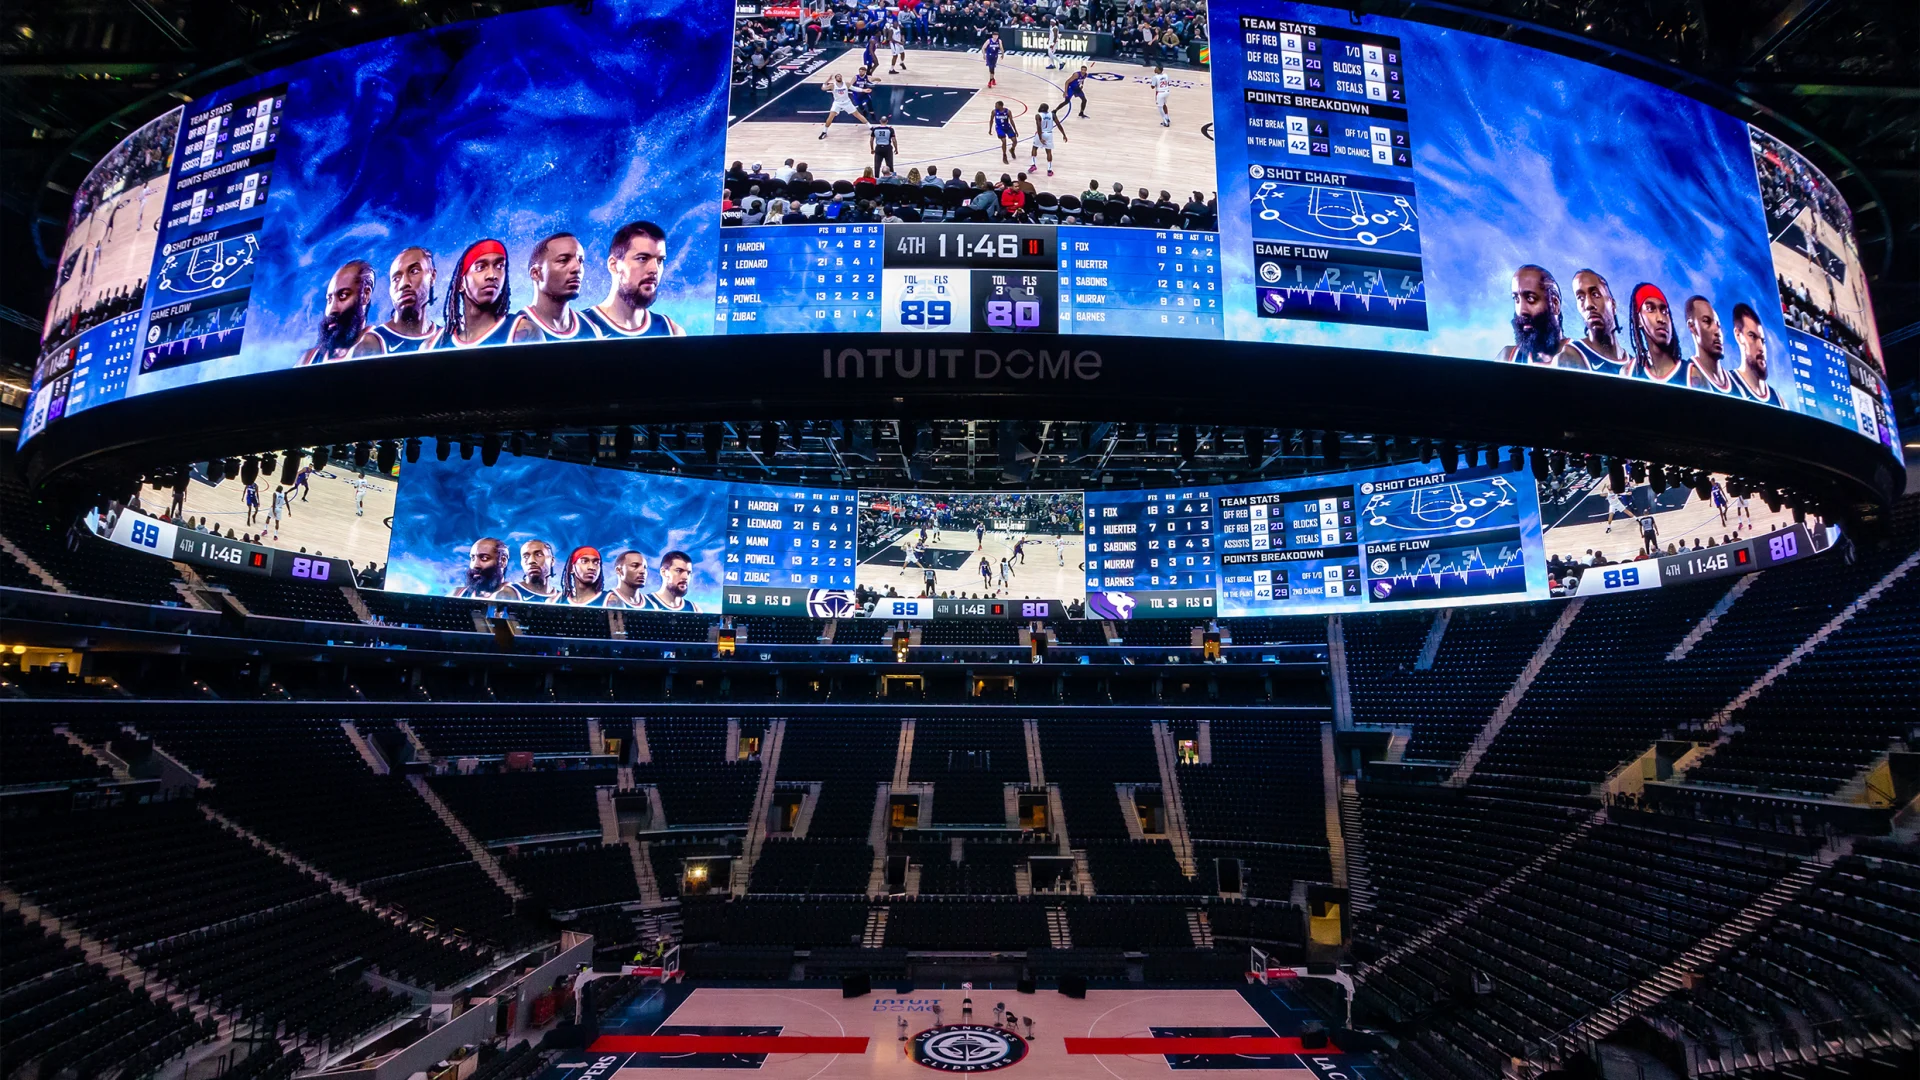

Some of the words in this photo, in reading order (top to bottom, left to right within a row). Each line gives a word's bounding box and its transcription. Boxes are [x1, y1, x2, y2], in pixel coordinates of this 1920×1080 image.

[1242, 18, 1276, 30] TEAM
[1280, 22, 1316, 35] STATS
[1022, 37, 1048, 48] BLACK
[1246, 33, 1260, 44] OFF
[1262, 34, 1277, 46] REB
[1288, 40, 1295, 48] 8
[1308, 42, 1315, 51] 6
[1247, 51, 1261, 62] DEF
[1263, 52, 1278, 64] REB
[1285, 57, 1300, 66] 28
[1306, 60, 1321, 69] 20
[1369, 51, 1376, 59] 3
[1389, 54, 1396, 62] 8
[1333, 62, 1361, 75] BLOCKS
[1370, 69, 1378, 77] 4
[1391, 72, 1398, 80] 3
[1247, 70, 1280, 83] ASSISTS
[1286, 75, 1301, 85] 22
[1309, 78, 1321, 88] 14
[1337, 81, 1363, 94] STEALS
[1373, 88, 1380, 96] 6
[1393, 90, 1400, 99] 2
[1248, 91, 1291, 105] POINTS
[1295, 96, 1369, 115] BREAKDOWN
[190, 112, 209, 126] TEAM
[209, 103, 233, 117] STATS
[1249, 118, 1264, 127] FAST
[1265, 119, 1285, 129] BREAK
[1292, 122, 1303, 131] 12
[1315, 124, 1322, 133] 4
[1345, 129, 1356, 138] OFF
[1375, 132, 1386, 142] 10
[1397, 135, 1404, 144] 2
[1248, 137, 1254, 145] IN
[1255, 138, 1266, 146] THE
[1268, 139, 1285, 148] PAINT
[1291, 140, 1306, 150] 42
[1313, 143, 1328, 153] 29
[1334, 145, 1346, 155] 2ND
[1348, 147, 1370, 158] CHANCE
[1379, 151, 1386, 159] 8
[1399, 154, 1406, 163] 4
[177, 173, 202, 190] POINTS
[202, 158, 250, 181] BREAKDOWN
[1267, 168, 1301, 181] SHOT
[1305, 172, 1347, 185] CHART
[171, 240, 190, 252] SHOT
[192, 231, 219, 246] CHART
[737, 242, 764, 251] HARDEN
[897, 237, 925, 254] 4TH
[939, 234, 1018, 258] 11:46
[1061, 242, 1067, 250] 5
[1075, 242, 1089, 251] FOX
[1256, 244, 1291, 256] GAME
[1295, 247, 1328, 260] FLOW
[736, 260, 768, 269] LEONARD
[818, 258, 827, 266] 21
[1076, 260, 1107, 269] HUERTER
[1158, 263, 1165, 271] 7
[734, 277, 755, 286] MANN
[904, 275, 917, 284] TOL
[934, 276, 948, 284] FLS
[992, 276, 1007, 285] TOL
[1023, 276, 1037, 285] FLS
[1295, 265, 1302, 282] 1
[1328, 268, 1341, 285] 2
[1060, 277, 1068, 285] 10
[1076, 277, 1107, 287] SABONIS
[1158, 280, 1168, 288] 12
[907, 286, 913, 294] 3
[996, 286, 1003, 295] 3
[717, 296, 727, 304] 24
[734, 294, 761, 303] POWELL
[816, 292, 825, 300] 13
[1061, 294, 1069, 302] 13
[1076, 295, 1105, 304] MURRAY
[150, 309, 169, 321] GAME
[170, 303, 191, 316] FLOW
[732, 312, 756, 321] ZUBAC
[816, 310, 825, 318] 10
[901, 301, 951, 325] 89
[988, 301, 1040, 327] 80
[1059, 312, 1070, 320] 40
[1076, 312, 1105, 322] BARNES
[1376, 480, 1405, 491] SHOT
[1409, 474, 1446, 487] CHART
[748, 501, 778, 512] HARDEN
[1221, 498, 1247, 506] TEAM
[1250, 495, 1280, 504] STATS
[1103, 508, 1118, 517] FOX
[747, 518, 782, 529] LEONARD
[1104, 524, 1136, 534] HUERTER
[131, 520, 159, 548] 89
[746, 536, 768, 546] MANN
[1104, 542, 1136, 552] SABONIS
[1367, 543, 1396, 553] GAME
[1400, 540, 1430, 550] FLOW
[1769, 532, 1798, 560] 80
[180, 539, 194, 552] 4TH
[200, 542, 242, 564] 11:46
[1224, 554, 1258, 563] POINTS
[1261, 550, 1324, 561] BREAKDOWN
[745, 554, 775, 564] POWELL
[1104, 559, 1134, 569] MURRAY
[1665, 564, 1680, 577] 4TH
[1688, 553, 1728, 575] 11:46
[292, 557, 330, 580] 80
[744, 572, 770, 582] ZUBAC
[1105, 577, 1134, 586] BARNES
[1604, 568, 1640, 589] 89
[728, 594, 742, 604] TOL
[747, 595, 756, 604] 3
[765, 596, 778, 605] FLS
[1150, 599, 1164, 608] TOL
[1168, 598, 1177, 608] 3
[1186, 598, 1200, 607] FLS
[893, 602, 918, 615] 89
[938, 605, 949, 614] 4TH
[955, 604, 985, 614] 11:46
[1022, 603, 1048, 617] 80
[916, 1029, 940, 1042] LOS
[950, 1026, 1018, 1043] ANGELES
[921, 1058, 1012, 1071] CLIPPERS
[1312, 1057, 1337, 1071] LA
